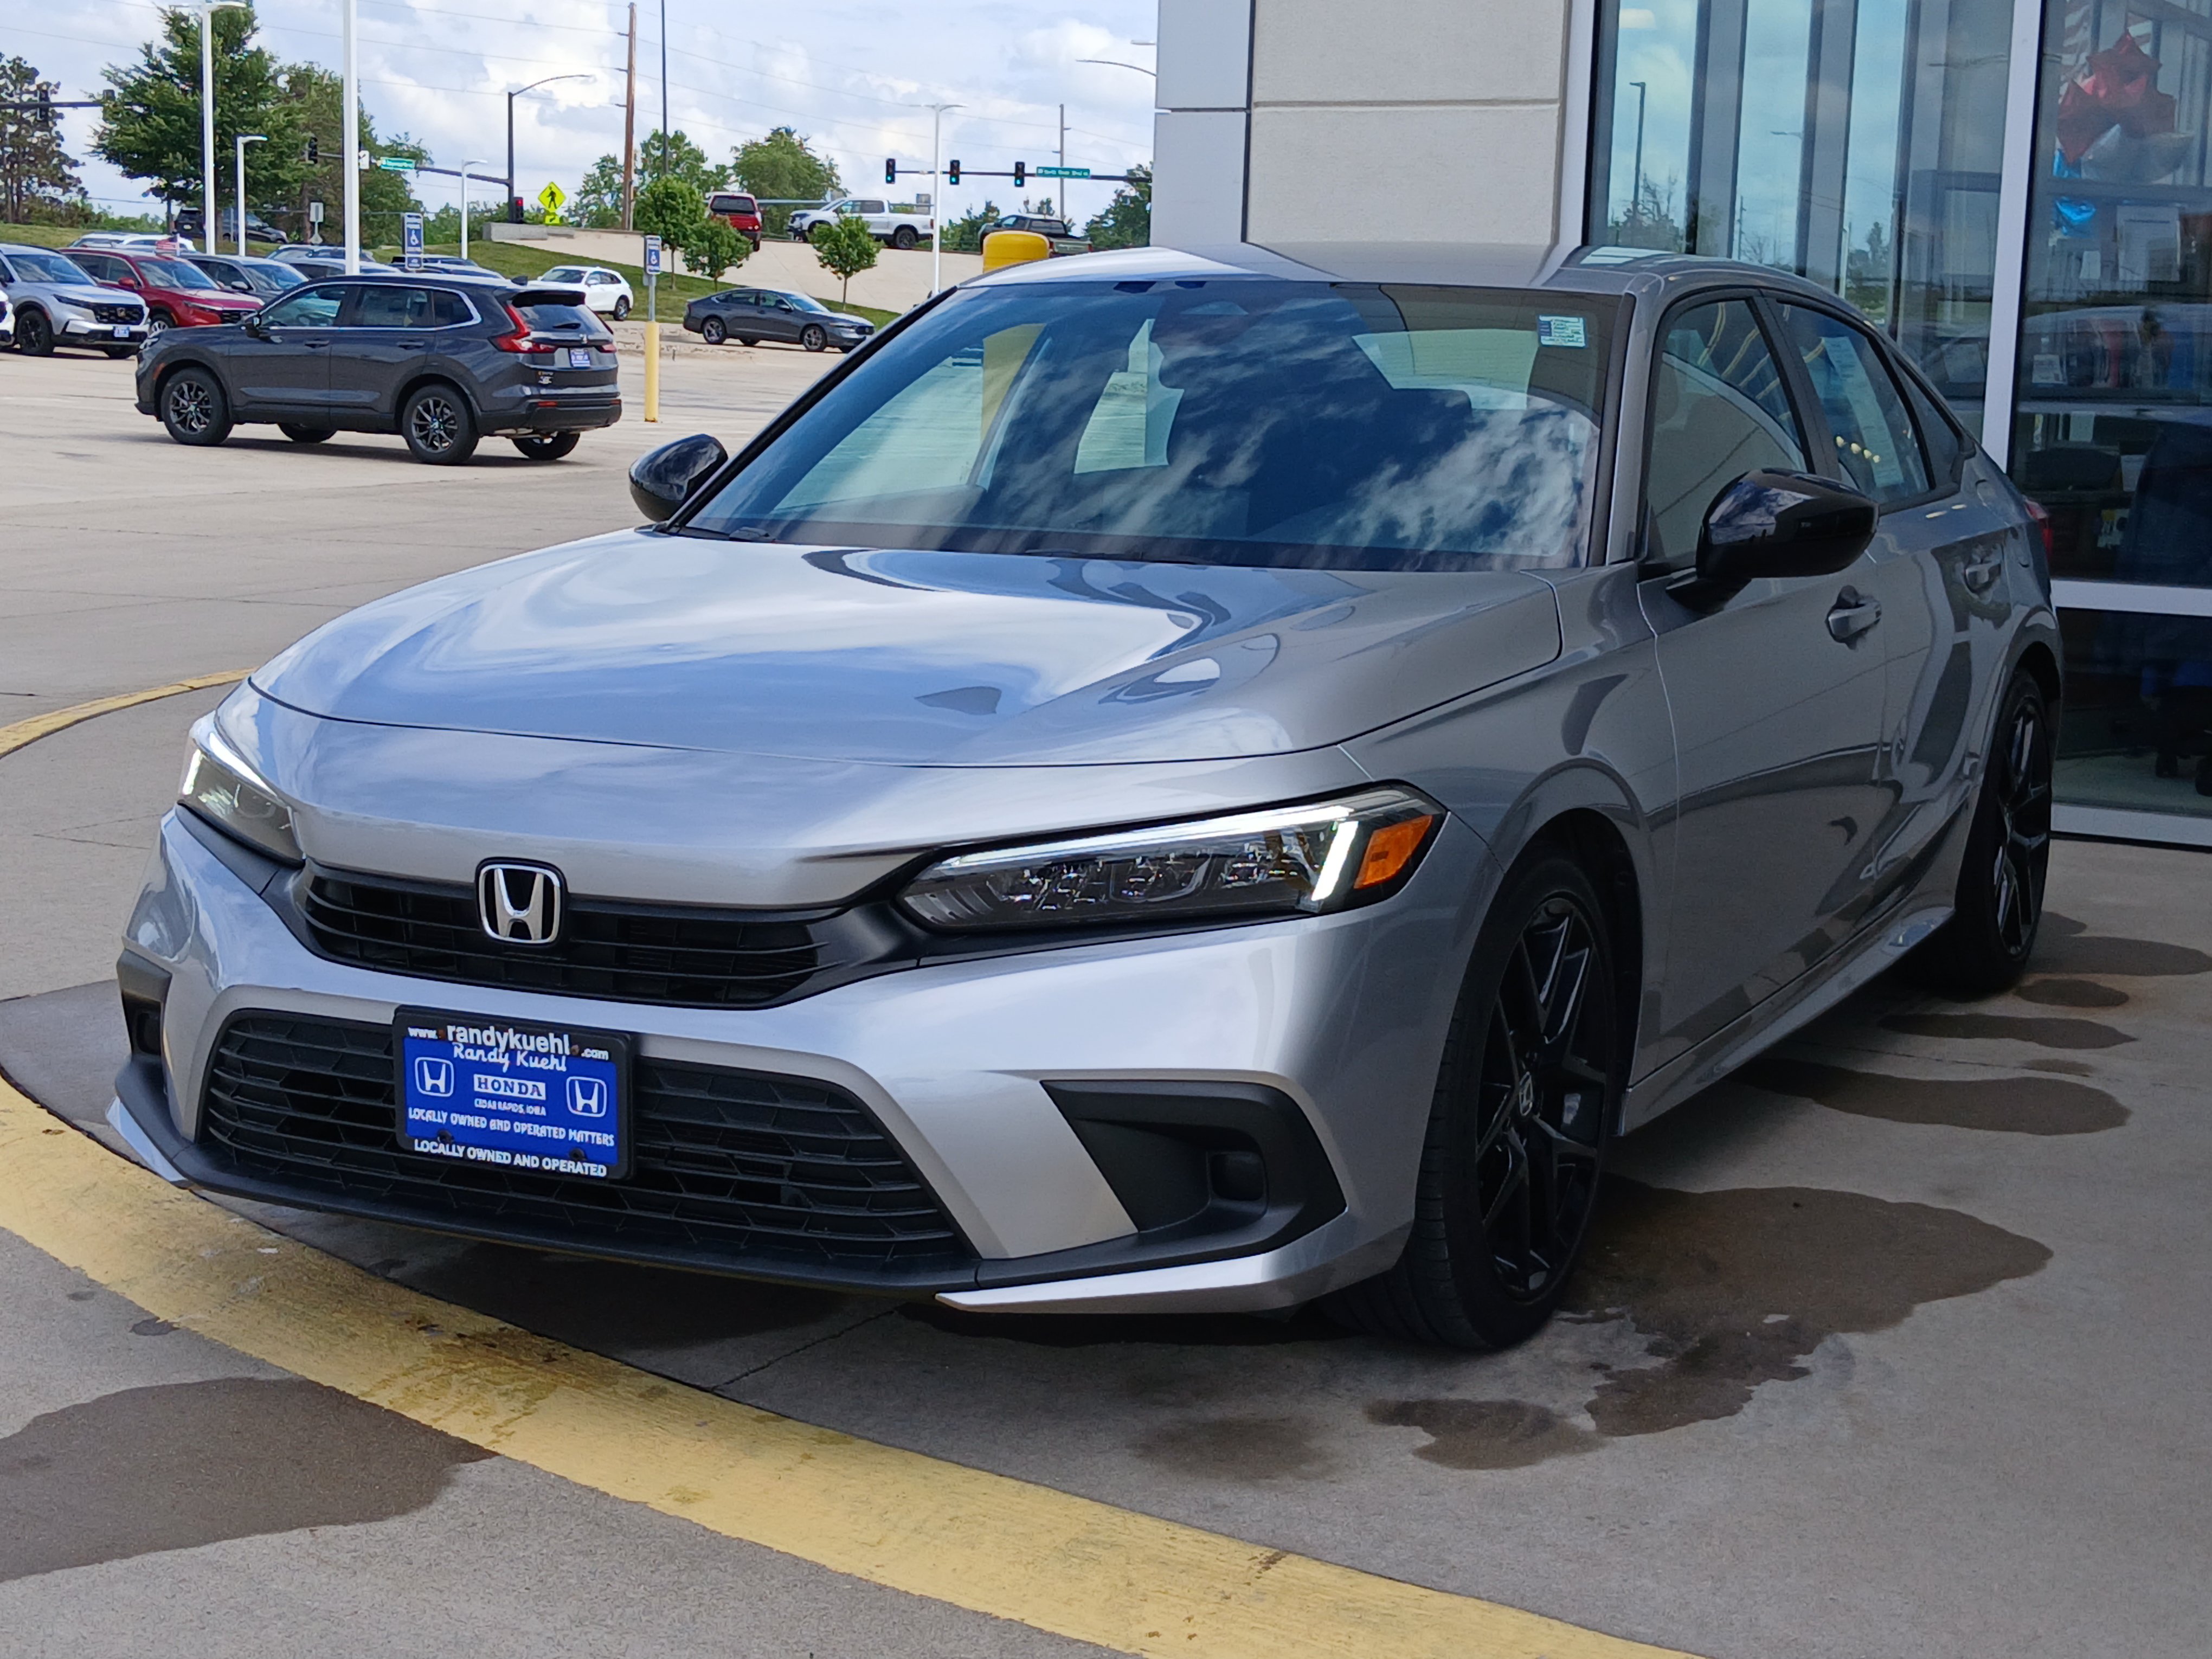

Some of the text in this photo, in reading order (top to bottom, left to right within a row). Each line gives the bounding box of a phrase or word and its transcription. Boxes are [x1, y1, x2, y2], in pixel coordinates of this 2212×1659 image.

[447, 1025, 570, 1056] randykuehl
[452, 1041, 567, 1073] Randy Kuehl
[478, 1077, 543, 1097] HONDA
[408, 1107, 615, 1147] LOCALLY OWNED AND OPERATED MATTERS
[414, 1139, 607, 1178] LOCALLY OWNED AND OPERATED
